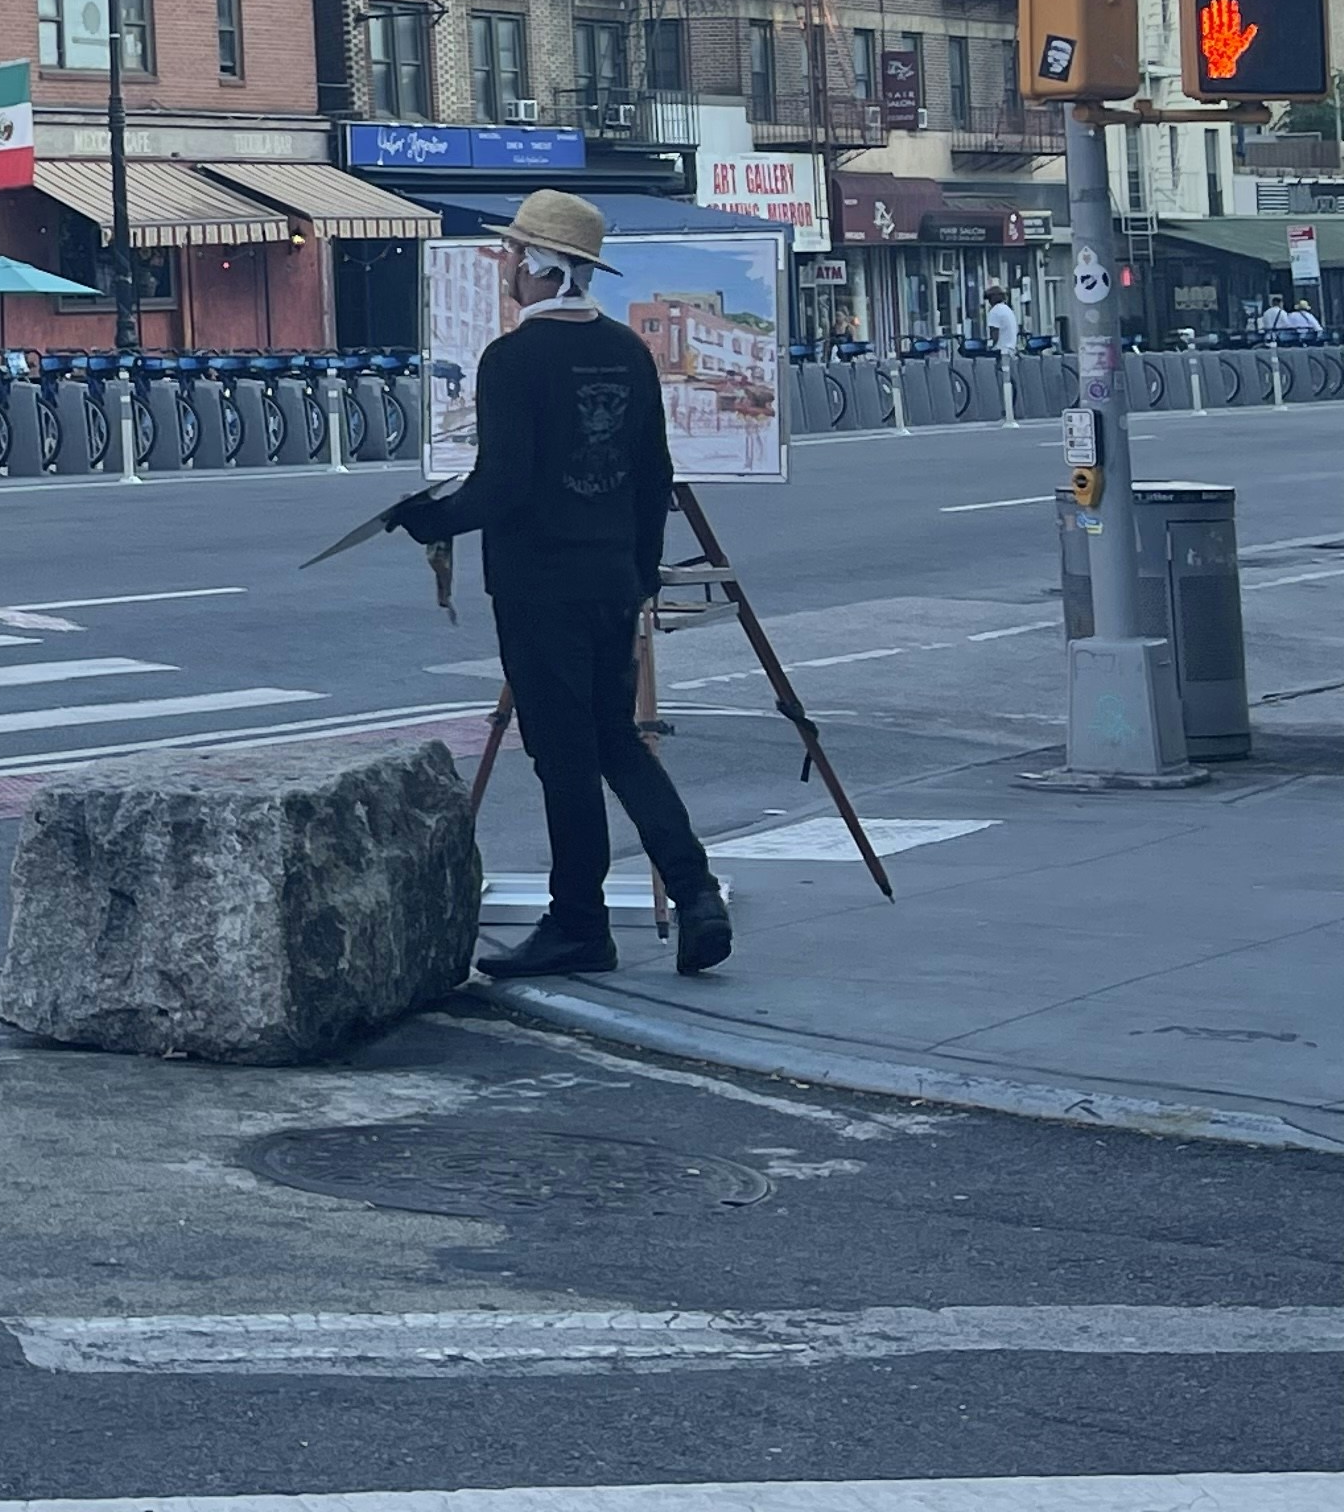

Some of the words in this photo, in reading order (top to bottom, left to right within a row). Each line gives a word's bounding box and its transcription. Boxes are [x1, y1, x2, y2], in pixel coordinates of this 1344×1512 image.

[122, 132, 153, 153] CAFE
[713, 163, 737, 194] ART
[745, 163, 795, 194] GALLERY
[767, 202, 814, 227] MIRROR
[816, 266, 844, 280] ATM
